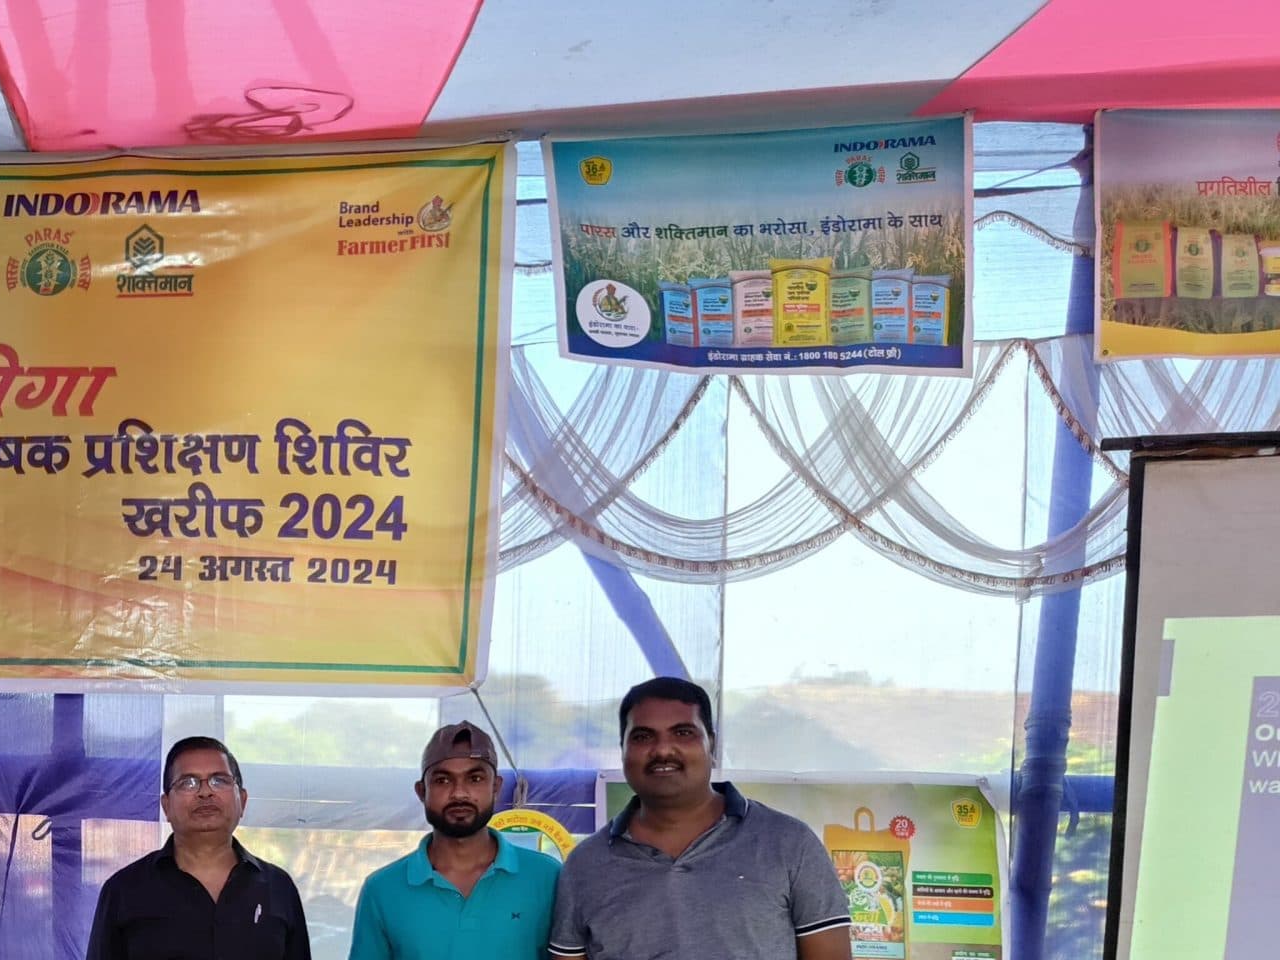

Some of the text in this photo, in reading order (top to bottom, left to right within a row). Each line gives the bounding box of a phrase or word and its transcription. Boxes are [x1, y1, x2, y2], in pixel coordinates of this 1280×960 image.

[834, 136, 936, 153] INDORAMA
[1196, 176, 1272, 196] प्रगतिशील
[3, 189, 201, 217] INDORAMA
[340, 201, 380, 214] Brand
[339, 213, 414, 228] Leadership
[580, 223, 616, 238] पारस
[621, 221, 650, 239] और
[655, 223, 728, 241] शक्तिमान
[733, 223, 754, 238] का
[820, 216, 883, 235] इंडोरामा
[887, 211, 904, 229] के
[908, 213, 943, 229] साथ
[24, 227, 72, 247] PARAS
[799, 351, 821, 361] 1800
[823, 350, 839, 361] 180
[84, 419, 260, 478] प्रशिक्षण
[275, 419, 413, 478] शिविर
[123, 482, 408, 541] खरीफ 2024
[139, 553, 397, 585] 24 अगस्त 2024
[896, 819, 908, 828] 20
